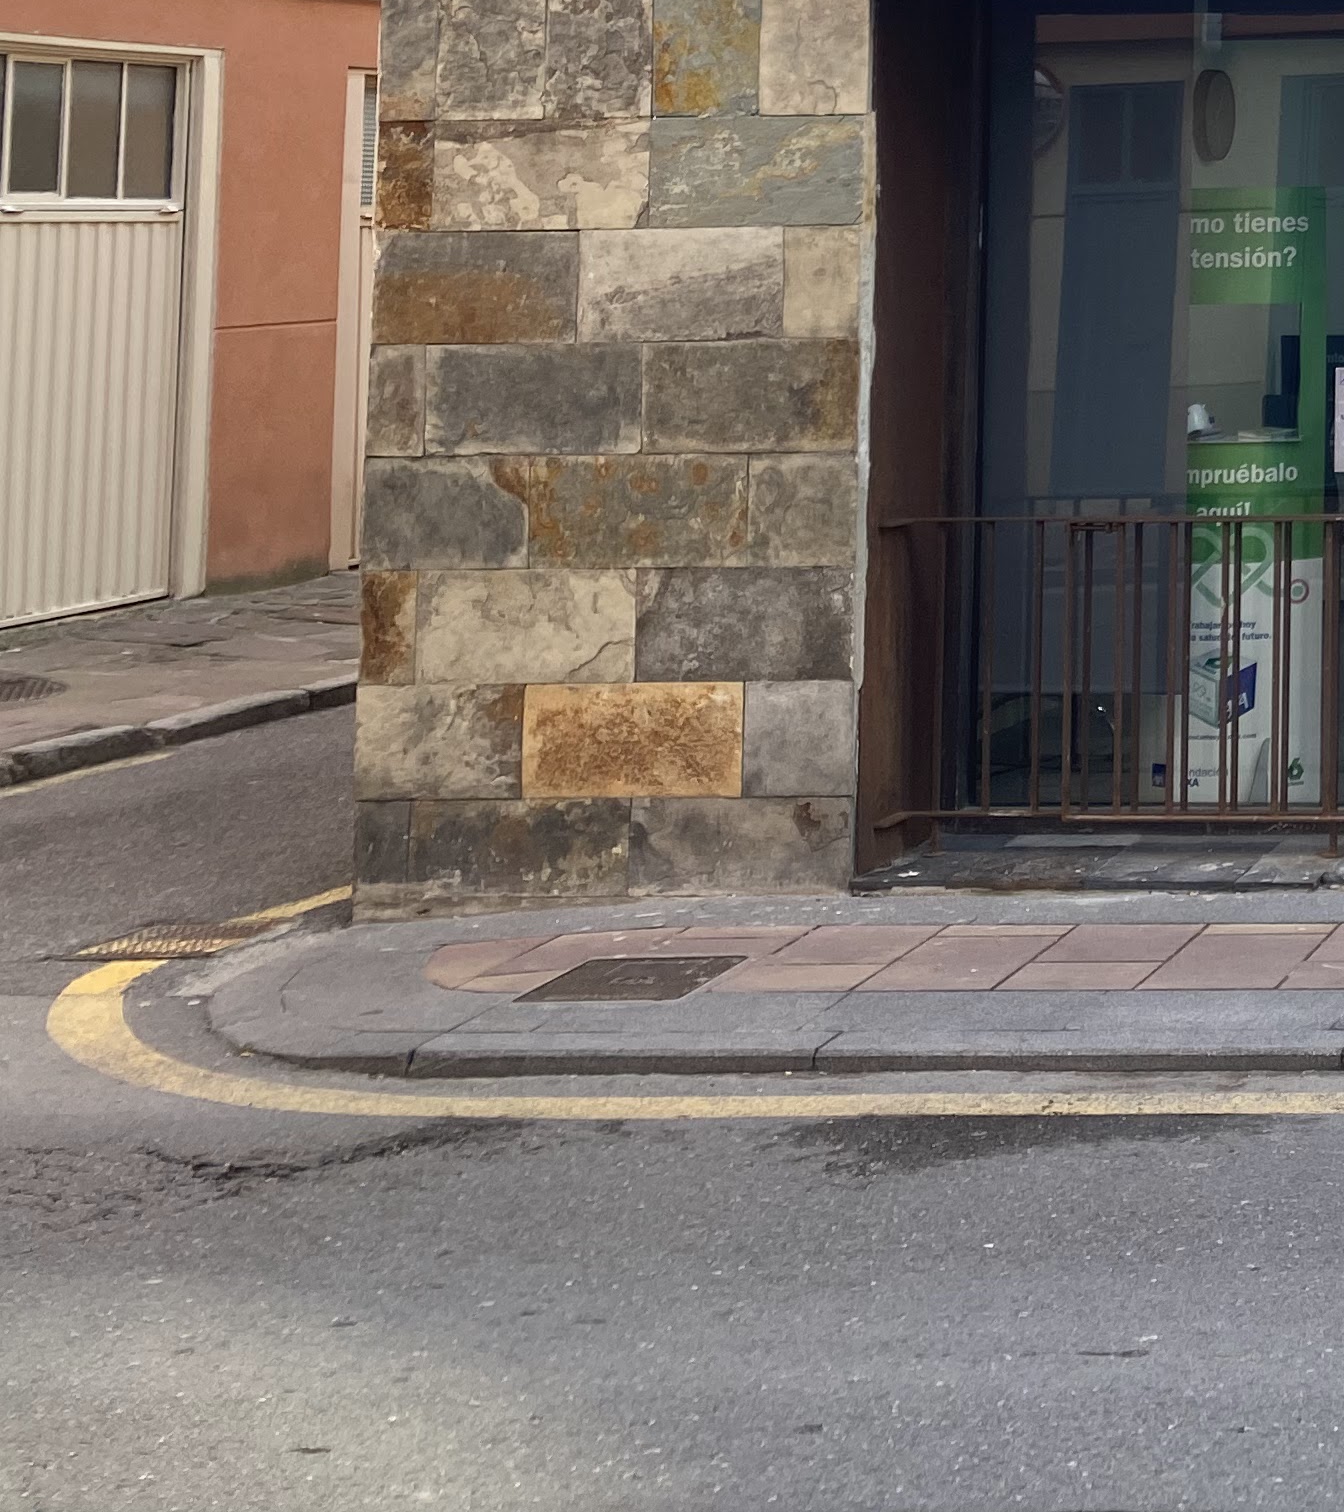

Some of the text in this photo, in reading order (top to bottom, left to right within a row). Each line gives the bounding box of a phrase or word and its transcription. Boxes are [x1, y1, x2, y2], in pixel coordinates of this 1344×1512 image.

[1232, 212, 1310, 233] tienes
[1190, 245, 1298, 269] tensión?
[1241, 632, 1272, 641] futuro.
